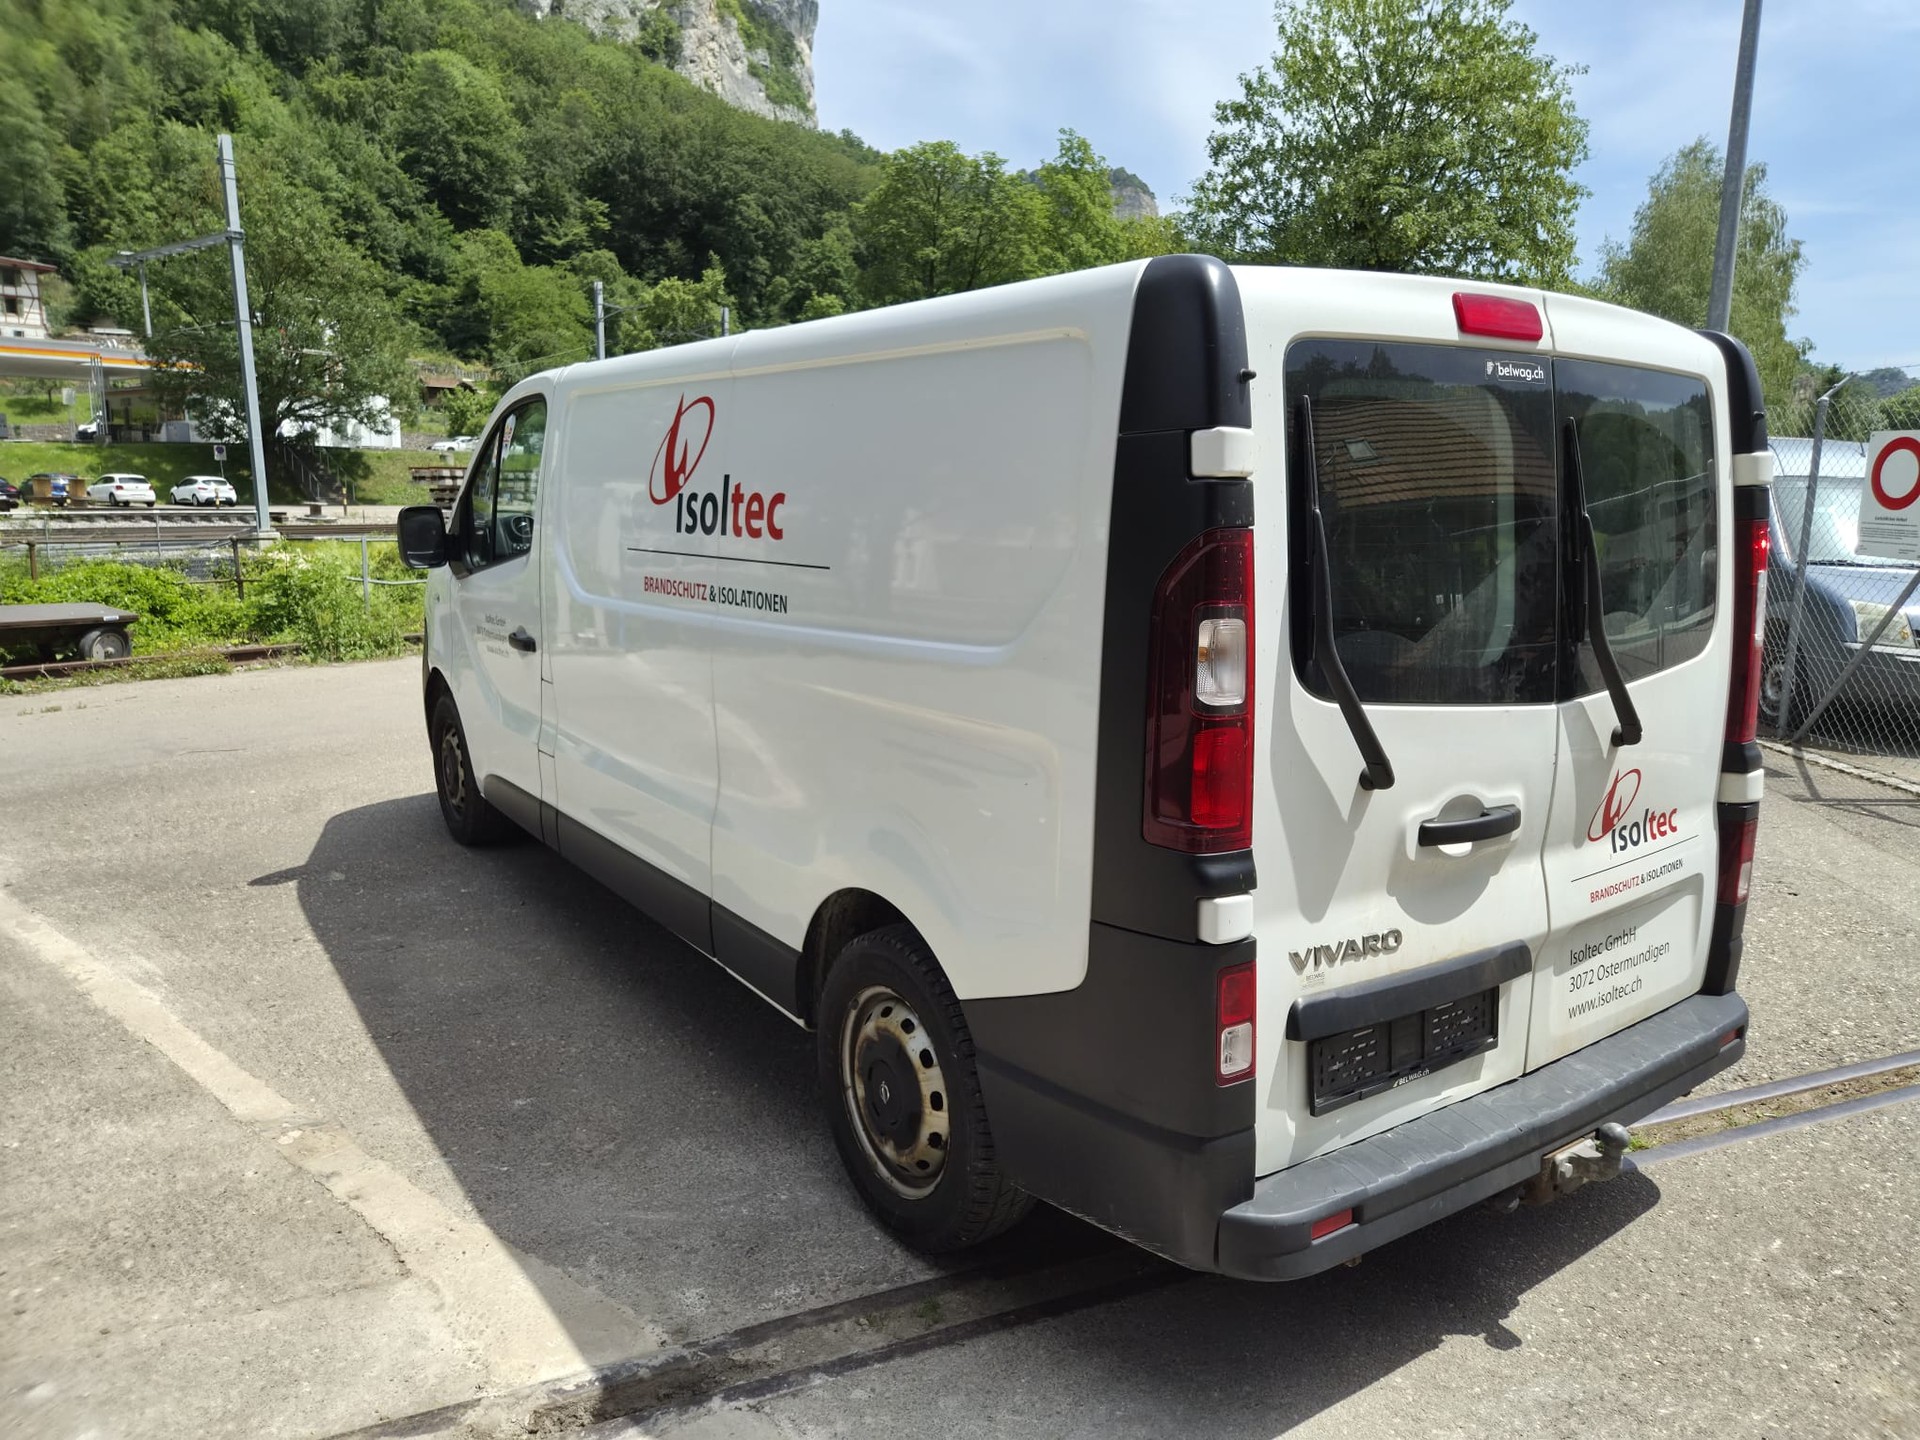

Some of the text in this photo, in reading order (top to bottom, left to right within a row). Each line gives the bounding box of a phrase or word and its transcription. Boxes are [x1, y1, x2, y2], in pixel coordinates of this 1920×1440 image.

[1498, 364, 1544, 381] belwag.ch
[676, 474, 786, 541] isoltec
[644, 576, 788, 614] BRANDSCHUTZ & ISOLATIONEN
[1611, 807, 1678, 854] isoltec
[1590, 858, 1683, 903] BRANDSCHUTZ & ISOLATIONEN
[1288, 928, 1403, 974] VIVARO
[1569, 941, 1670, 993] 3072 Ostermundigen
[1570, 926, 1637, 966] Isoltec GmbH
[1568, 976, 1643, 1019] www.isoltec.ch
